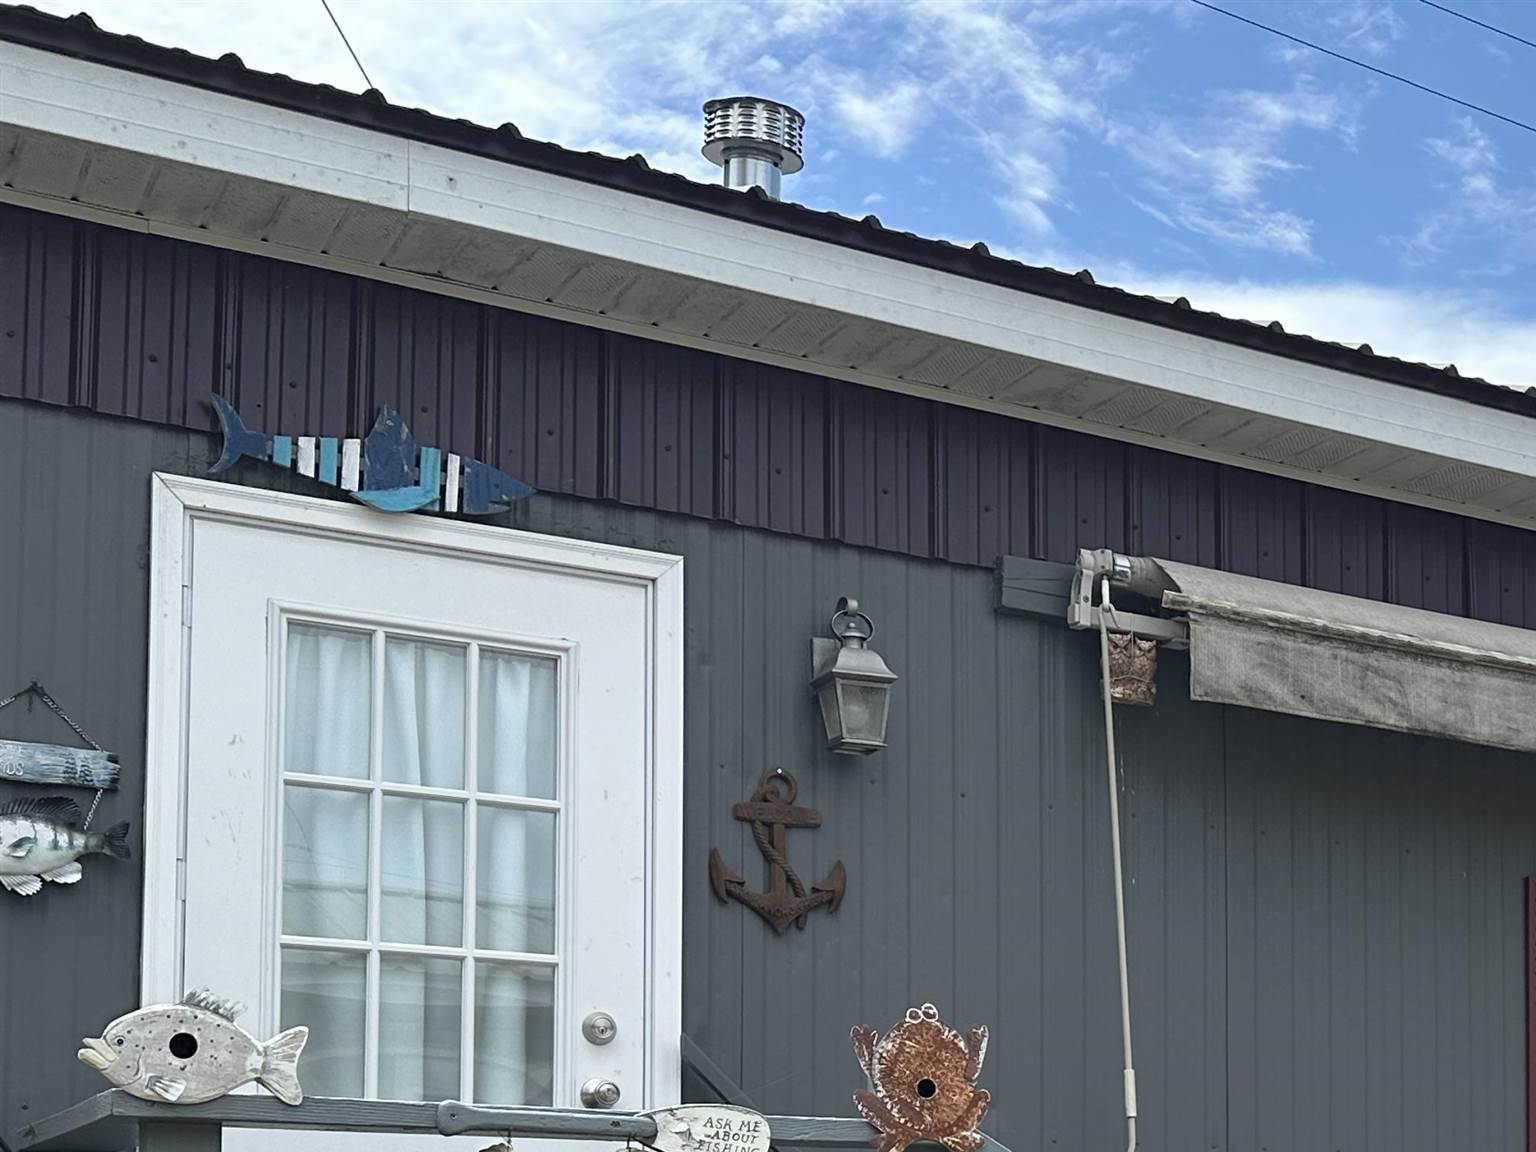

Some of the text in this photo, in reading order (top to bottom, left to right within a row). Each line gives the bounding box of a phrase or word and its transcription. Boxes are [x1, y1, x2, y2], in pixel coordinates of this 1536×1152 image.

[703, 1116, 762, 1133] ASK ME
[710, 1130, 760, 1144] ABOUT
